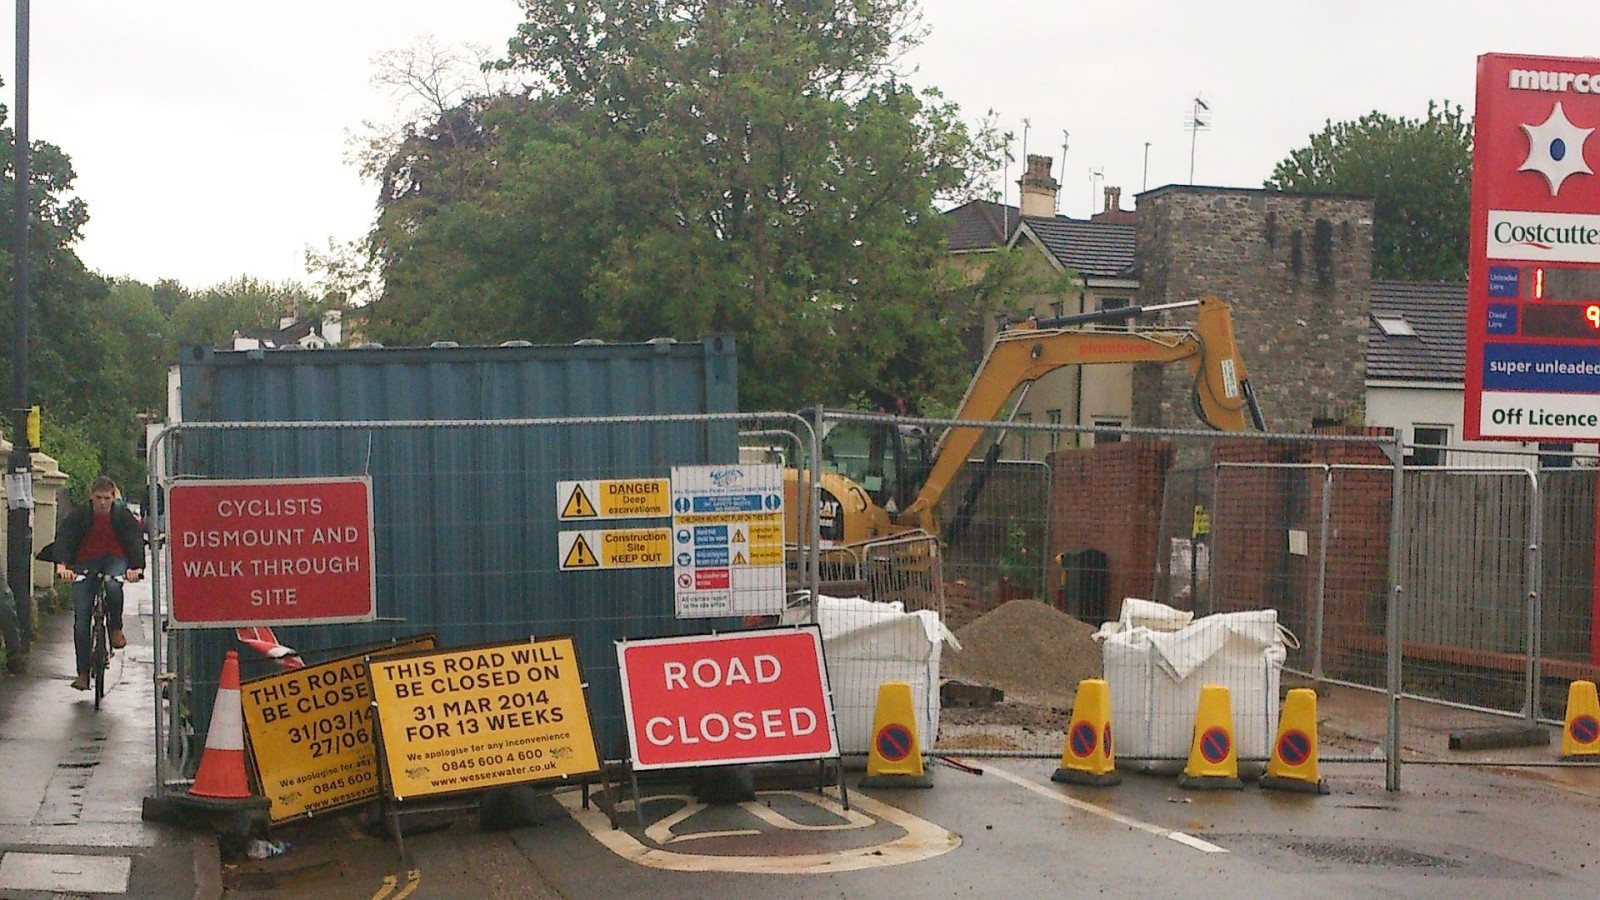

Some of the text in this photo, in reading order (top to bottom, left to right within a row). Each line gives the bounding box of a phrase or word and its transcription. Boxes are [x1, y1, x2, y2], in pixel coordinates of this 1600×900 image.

[1494, 221, 1600, 245] Costcutte
[1490, 360, 1531, 375] super
[1492, 408, 1598, 426] Off Licence
[609, 484, 659, 494] DANGER
[623, 496, 646, 505] Deep
[218, 498, 322, 517] CYCLISTS
[609, 505, 661, 514] excavations
[183, 527, 359, 547] DISMOUNT AND
[605, 533, 666, 542] Construction
[627, 543, 645, 551] Site
[183, 556, 360, 577] WALK THROUGH
[611, 553, 661, 563] KEEP OUT
[250, 588, 297, 606] SITE
[384, 646, 563, 681] THIS ROAD WILL
[664, 655, 782, 690] ROAD
[250, 664, 366, 705] THIS ROAD
[395, 665, 560, 698] BE CLOSED ON
[262, 682, 368, 724] BE CLOSE
[413, 689, 549, 721] 31 MAR 2014
[406, 707, 564, 742] FOR 13 WEEKS
[645, 707, 817, 746] CLOSED
[425, 746, 468, 760] apologise
[470, 744, 485, 752] for
[487, 742, 503, 751] any
[506, 732, 570, 747] inconvenience
[442, 749, 543, 772] 0845 600 4 600
[280, 759, 371, 788] We apologise for any
[313, 772, 371, 795] 0845 600
[430, 761, 556, 787] www.wessexwater.co.uk
